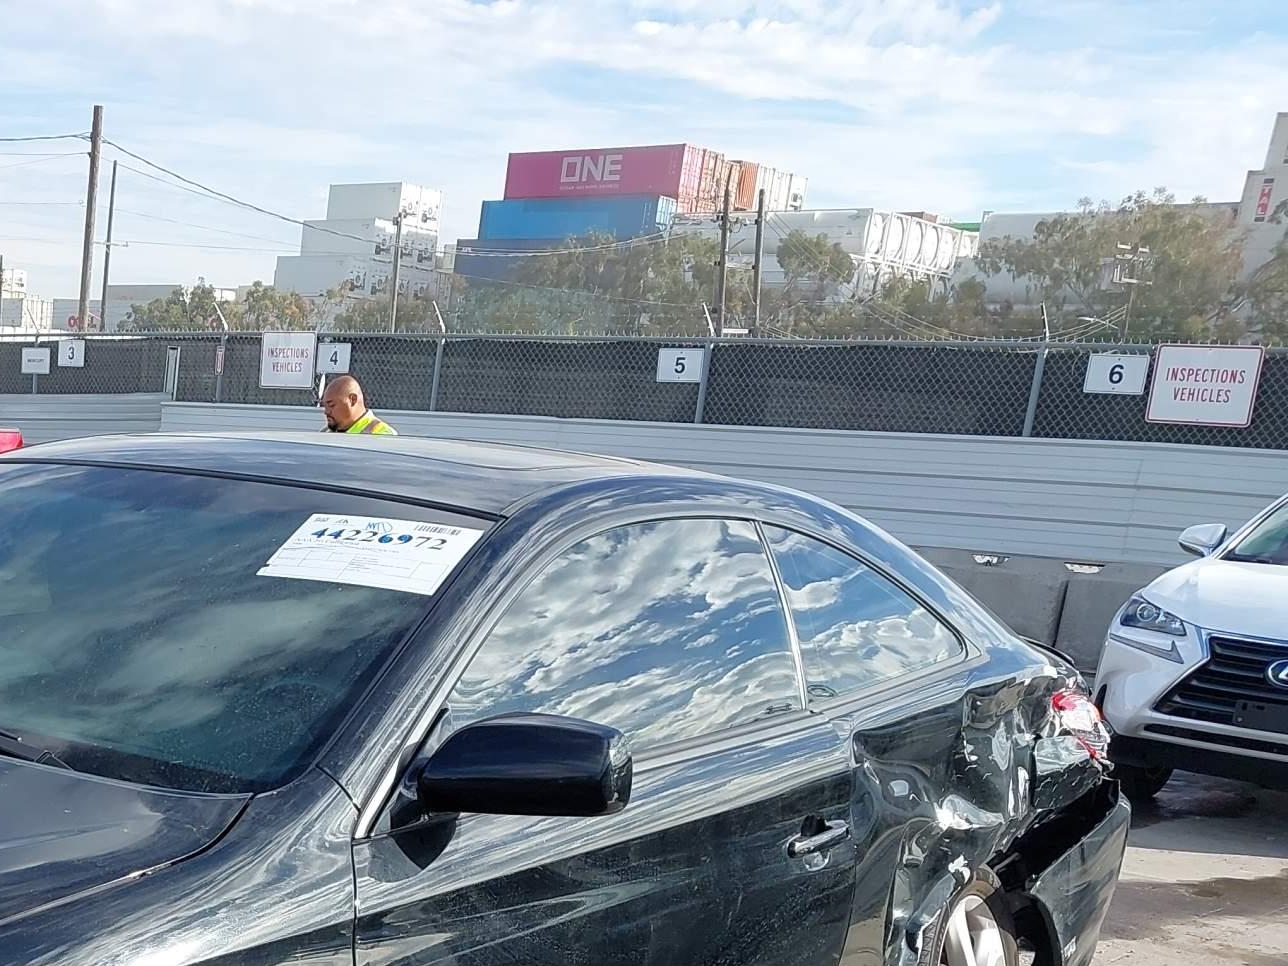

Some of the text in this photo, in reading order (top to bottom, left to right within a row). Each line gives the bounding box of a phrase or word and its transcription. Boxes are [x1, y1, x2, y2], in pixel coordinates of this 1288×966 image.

[560, 154, 623, 183] ONE
[68, 346, 75, 360] 3
[267, 347, 309, 359] INSPECTIONS
[329, 350, 339, 366] 4
[272, 361, 303, 373] VEHICLES
[674, 357, 686, 374] 5
[1108, 364, 1125, 384] 6
[1166, 367, 1246, 384] INSPECTIONS
[1173, 387, 1231, 403] VEHICLES
[311, 526, 448, 550] 44226972
